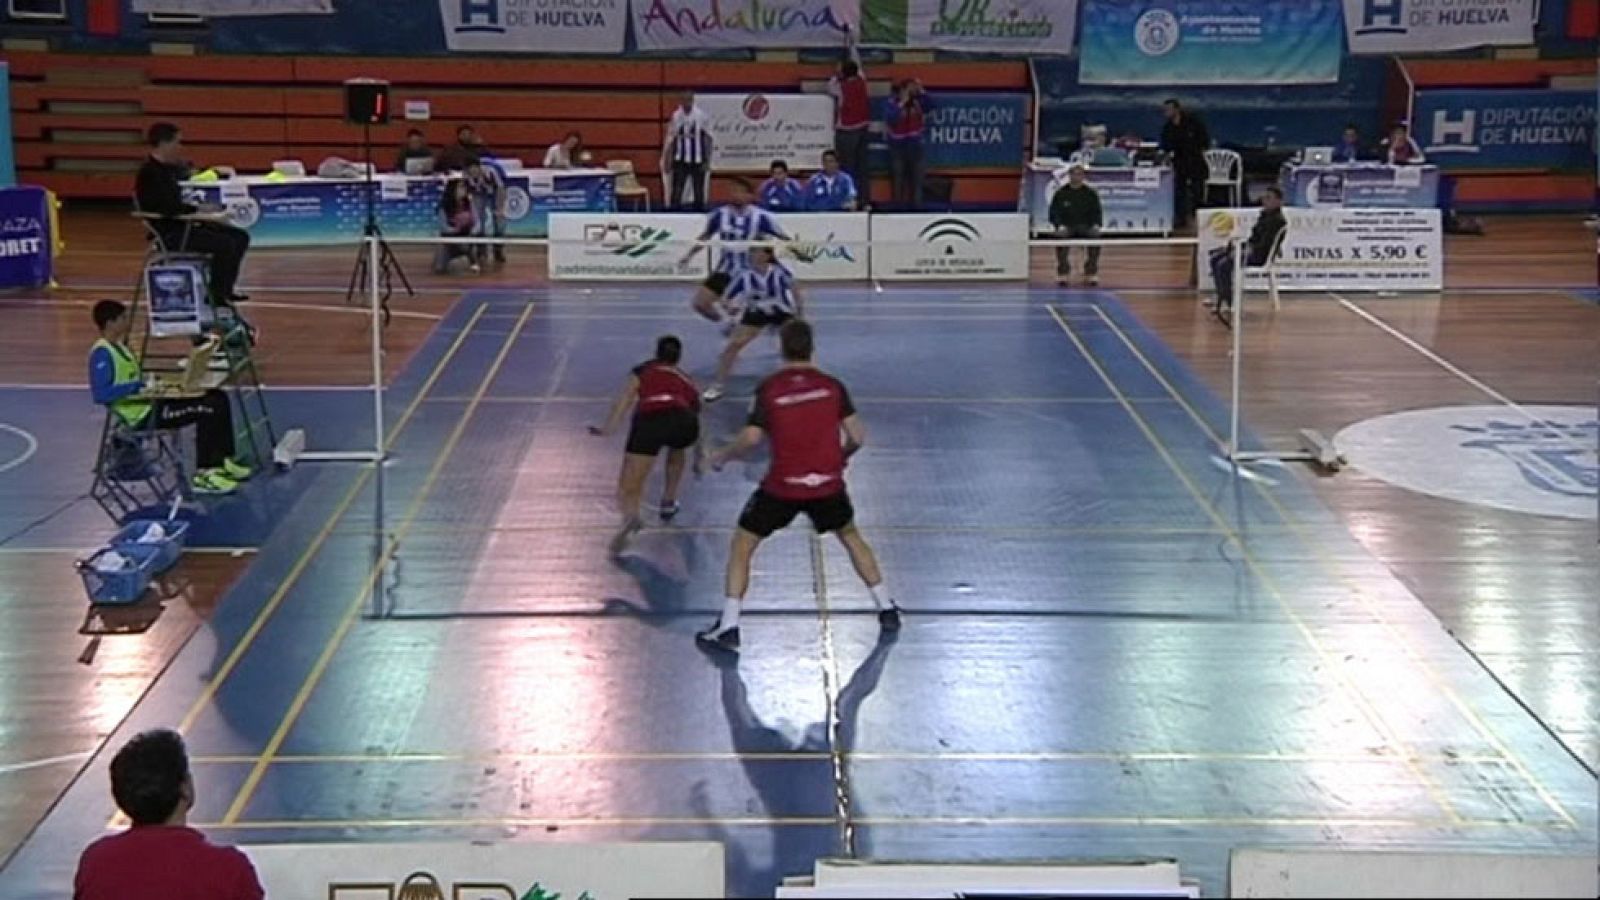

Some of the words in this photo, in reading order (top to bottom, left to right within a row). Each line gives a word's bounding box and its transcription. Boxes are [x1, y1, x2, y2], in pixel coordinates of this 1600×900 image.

[505, 12, 530, 26] DE
[535, 11, 606, 27] HUELVA
[1409, 11, 1433, 27] DE
[1438, 8, 1510, 26] HUELVA
[931, 126, 1002, 143] HUELVA
[1481, 128, 1505, 145] DE
[1511, 126, 1588, 144] HUELVA
[1293, 246, 1343, 259] TINTAS
[1352, 247, 1361, 259] X
[1370, 245, 1407, 260] 5,90
[1415, 244, 1428, 259] €
